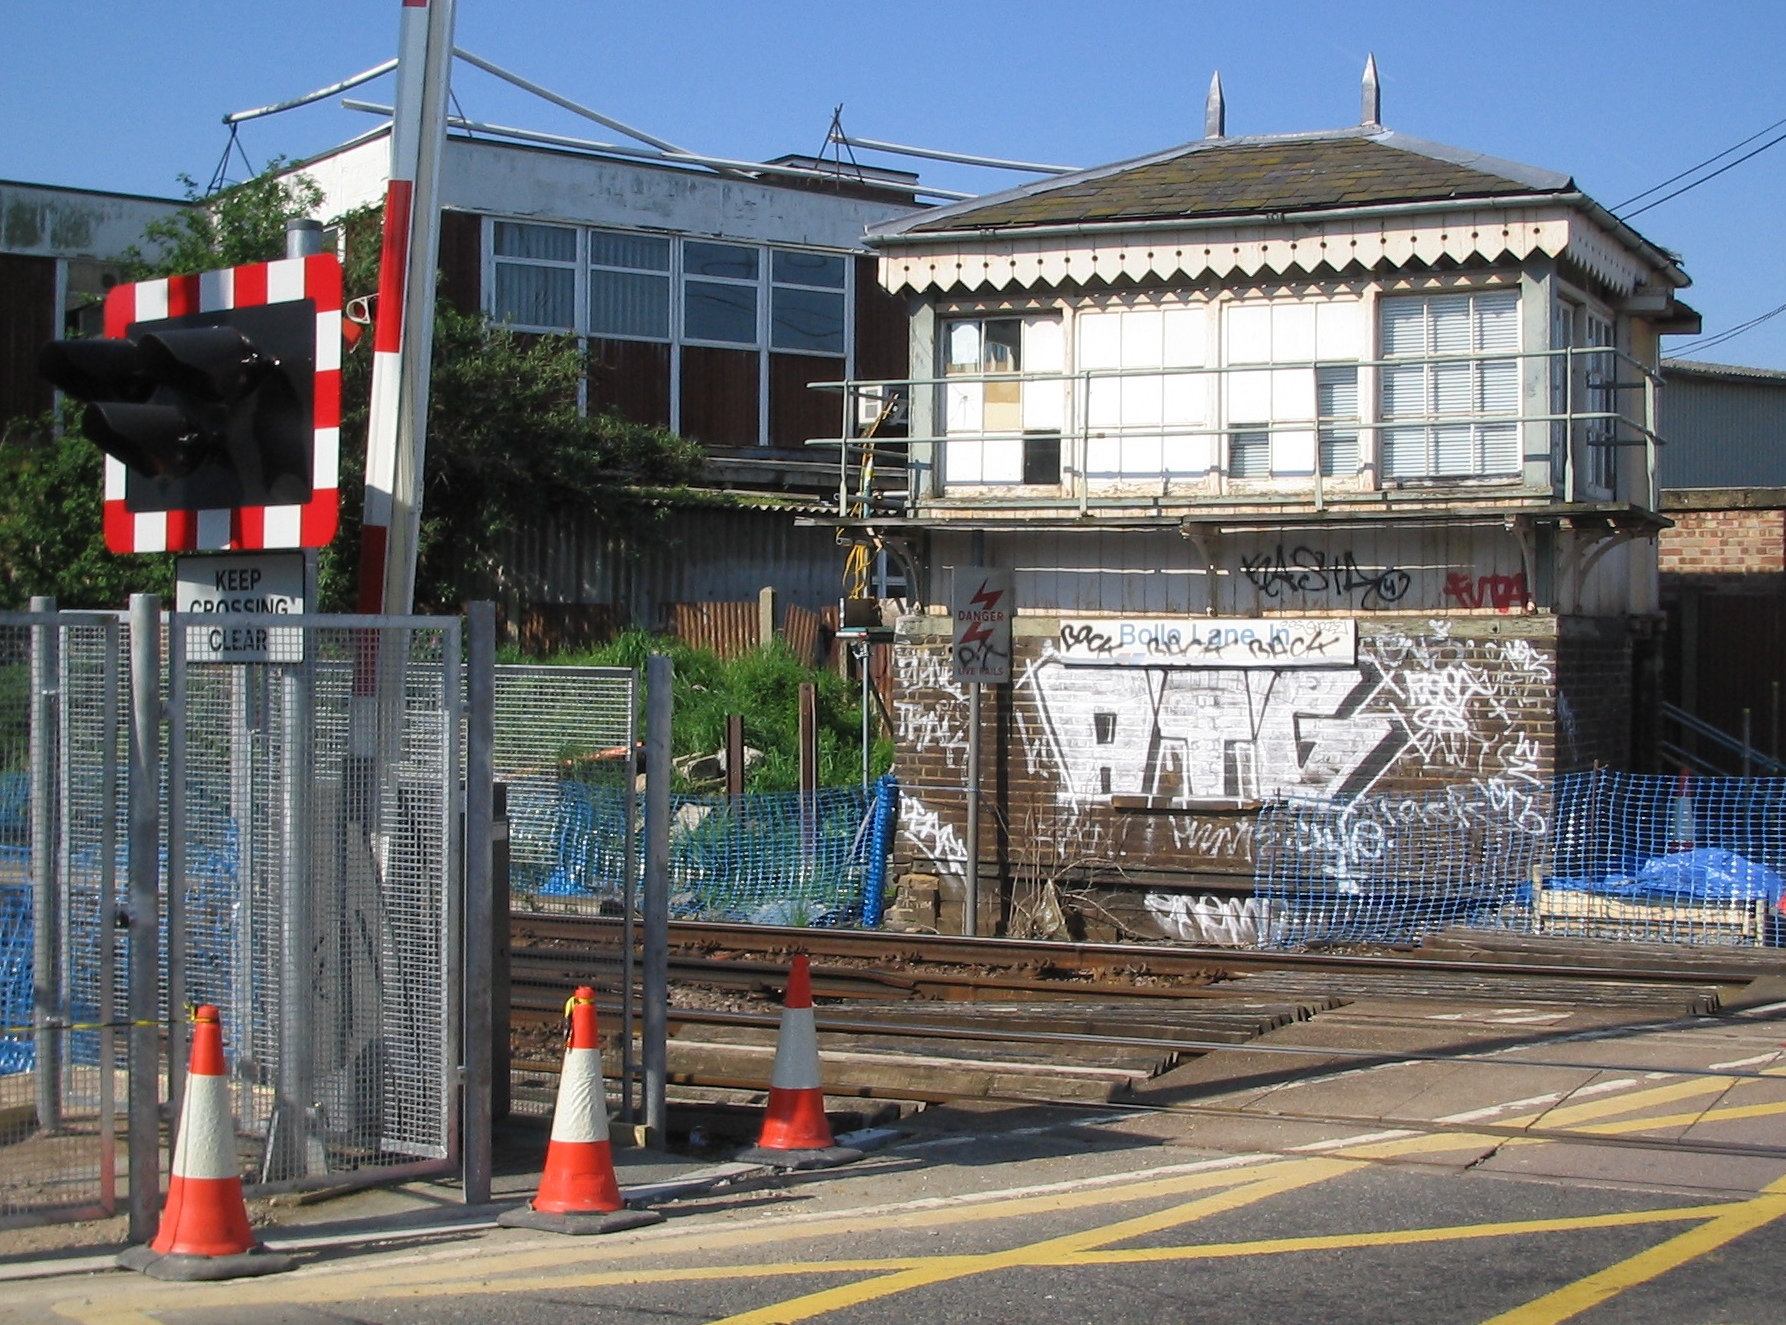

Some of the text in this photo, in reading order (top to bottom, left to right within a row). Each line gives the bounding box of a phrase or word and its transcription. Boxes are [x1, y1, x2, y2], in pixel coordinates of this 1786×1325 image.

[215, 568, 262, 591] KEEP
[190, 598, 288, 614] CROSSING
[958, 610, 1004, 622] DANGER
[209, 628, 268, 652] CLEAR
[1120, 623, 1182, 646] Bollo
[1193, 623, 1256, 646] Lane
